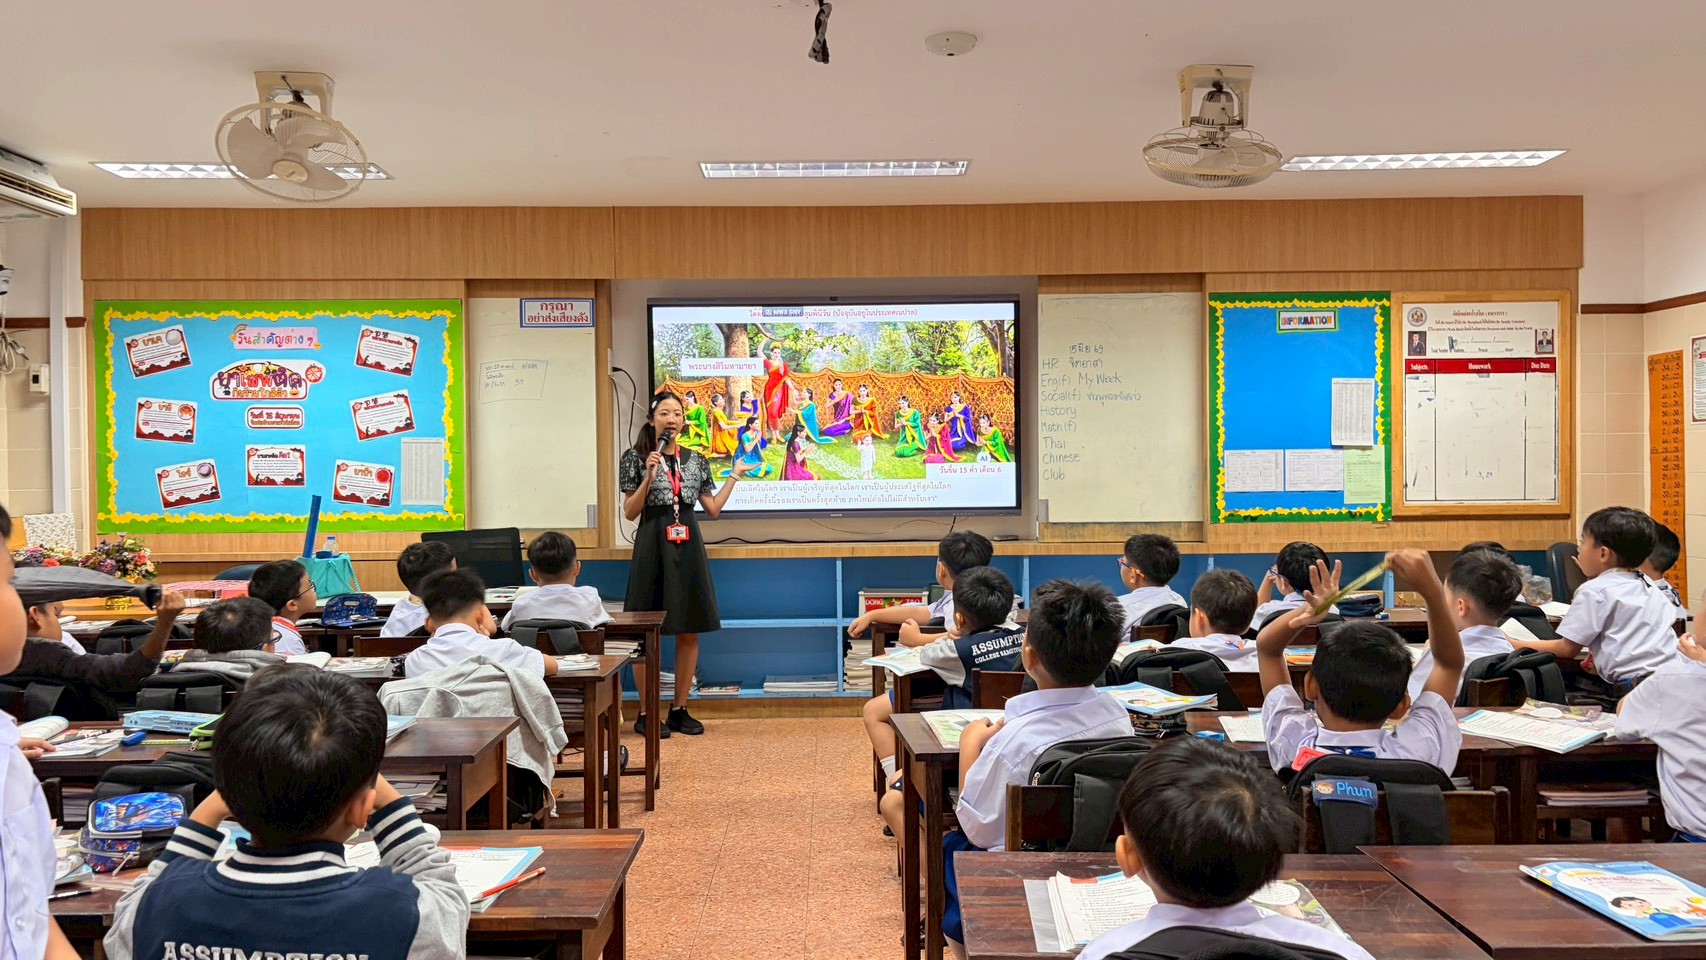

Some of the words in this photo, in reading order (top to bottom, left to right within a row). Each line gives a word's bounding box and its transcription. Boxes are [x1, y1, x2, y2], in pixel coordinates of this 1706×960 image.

[540, 302, 574, 314] กรุณา
[527, 312, 588, 323] อย่าส่งเสียงดัง
[1281, 316, 1332, 326] INFORMATION
[237, 329, 304, 347] วันสำคัญต่าง
[688, 361, 757, 371] พระนางสิริมหามายา
[1042, 358, 1059, 369] HR
[1410, 363, 1429, 371] Subjects
[1468, 362, 1491, 370] Homework
[1531, 361, 1540, 369] Due
[1540, 361, 1550, 369] Date
[217, 367, 303, 389] ยาเสพติด
[1079, 372, 1093, 389] My
[1096, 371, 1122, 385] Week
[1040, 406, 1077, 419] History
[1043, 437, 1066, 449] Thai
[1042, 453, 1081, 465] Chinese
[1043, 469, 1065, 480] Club
[974, 651, 1001, 664] COLLEGE
